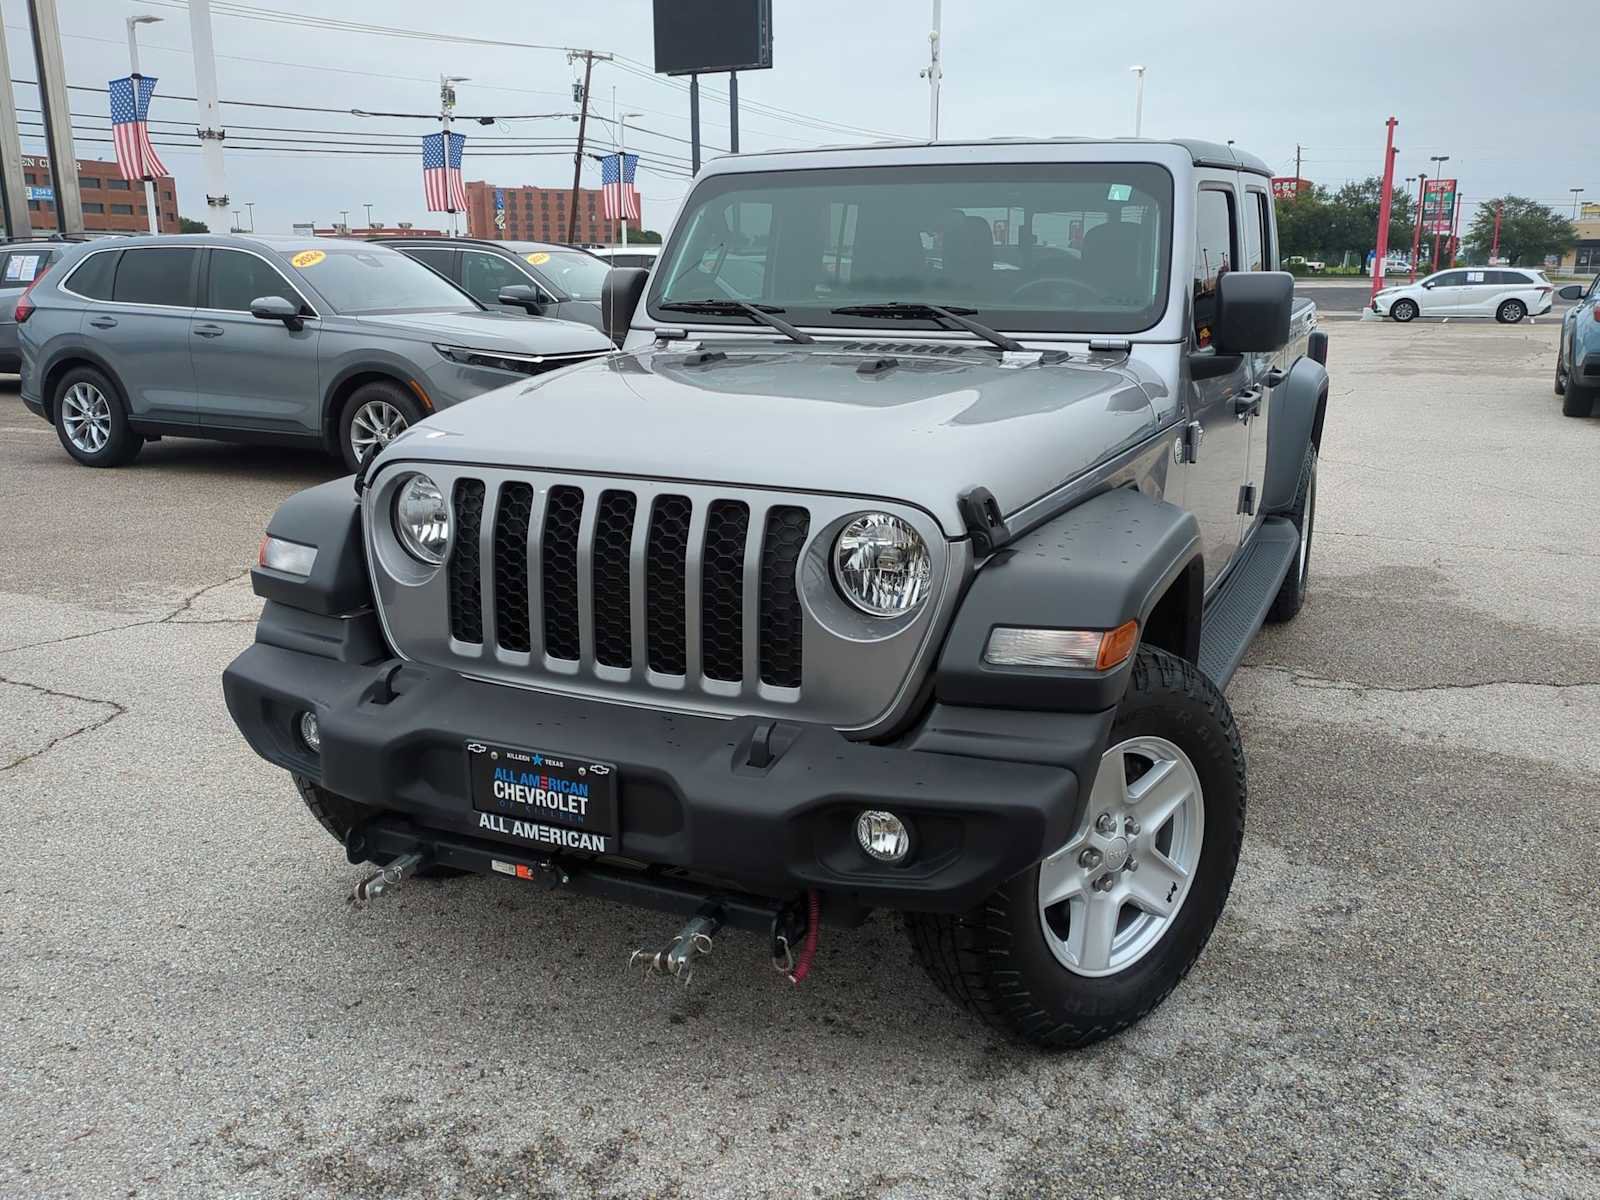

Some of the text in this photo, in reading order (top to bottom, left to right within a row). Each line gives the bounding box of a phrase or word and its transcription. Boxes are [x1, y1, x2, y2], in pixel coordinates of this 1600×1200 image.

[506, 752, 564, 768] KILLEEN TEXAS
[493, 780, 589, 815] CHEVROLET
[494, 767, 588, 797] ALL AMERICAN
[479, 813, 605, 852] ALL AMERICAN
